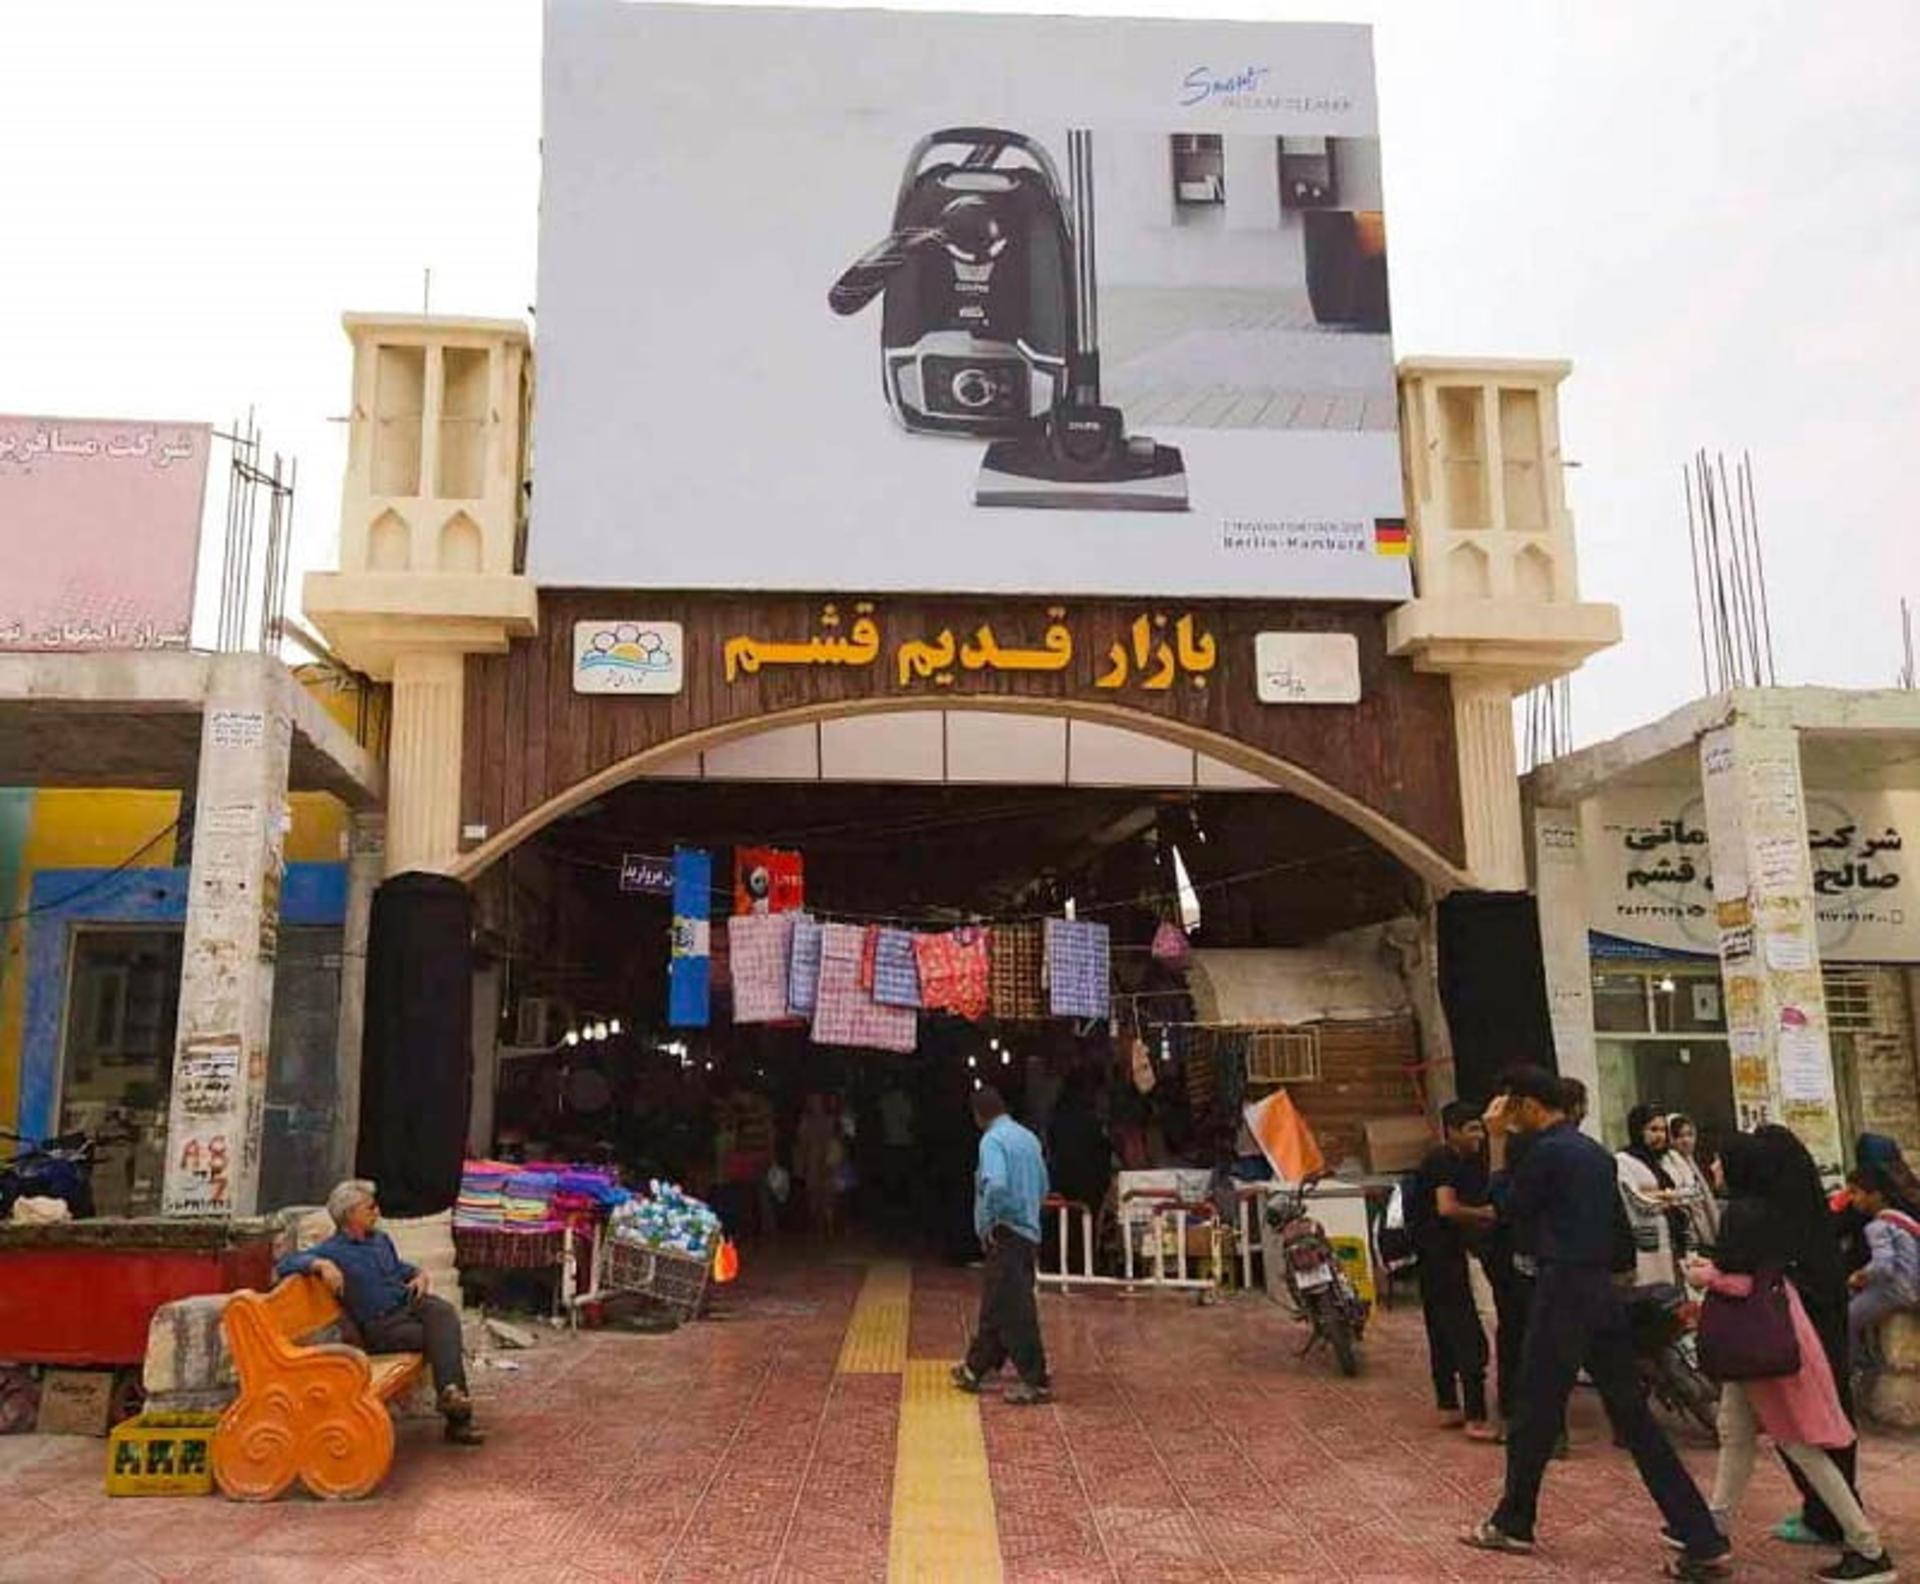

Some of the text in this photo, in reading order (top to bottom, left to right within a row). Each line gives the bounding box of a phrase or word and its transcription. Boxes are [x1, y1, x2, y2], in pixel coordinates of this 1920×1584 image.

[724, 602, 1216, 690] بازار قدیم قشم
[1626, 856, 1696, 890] قشم
